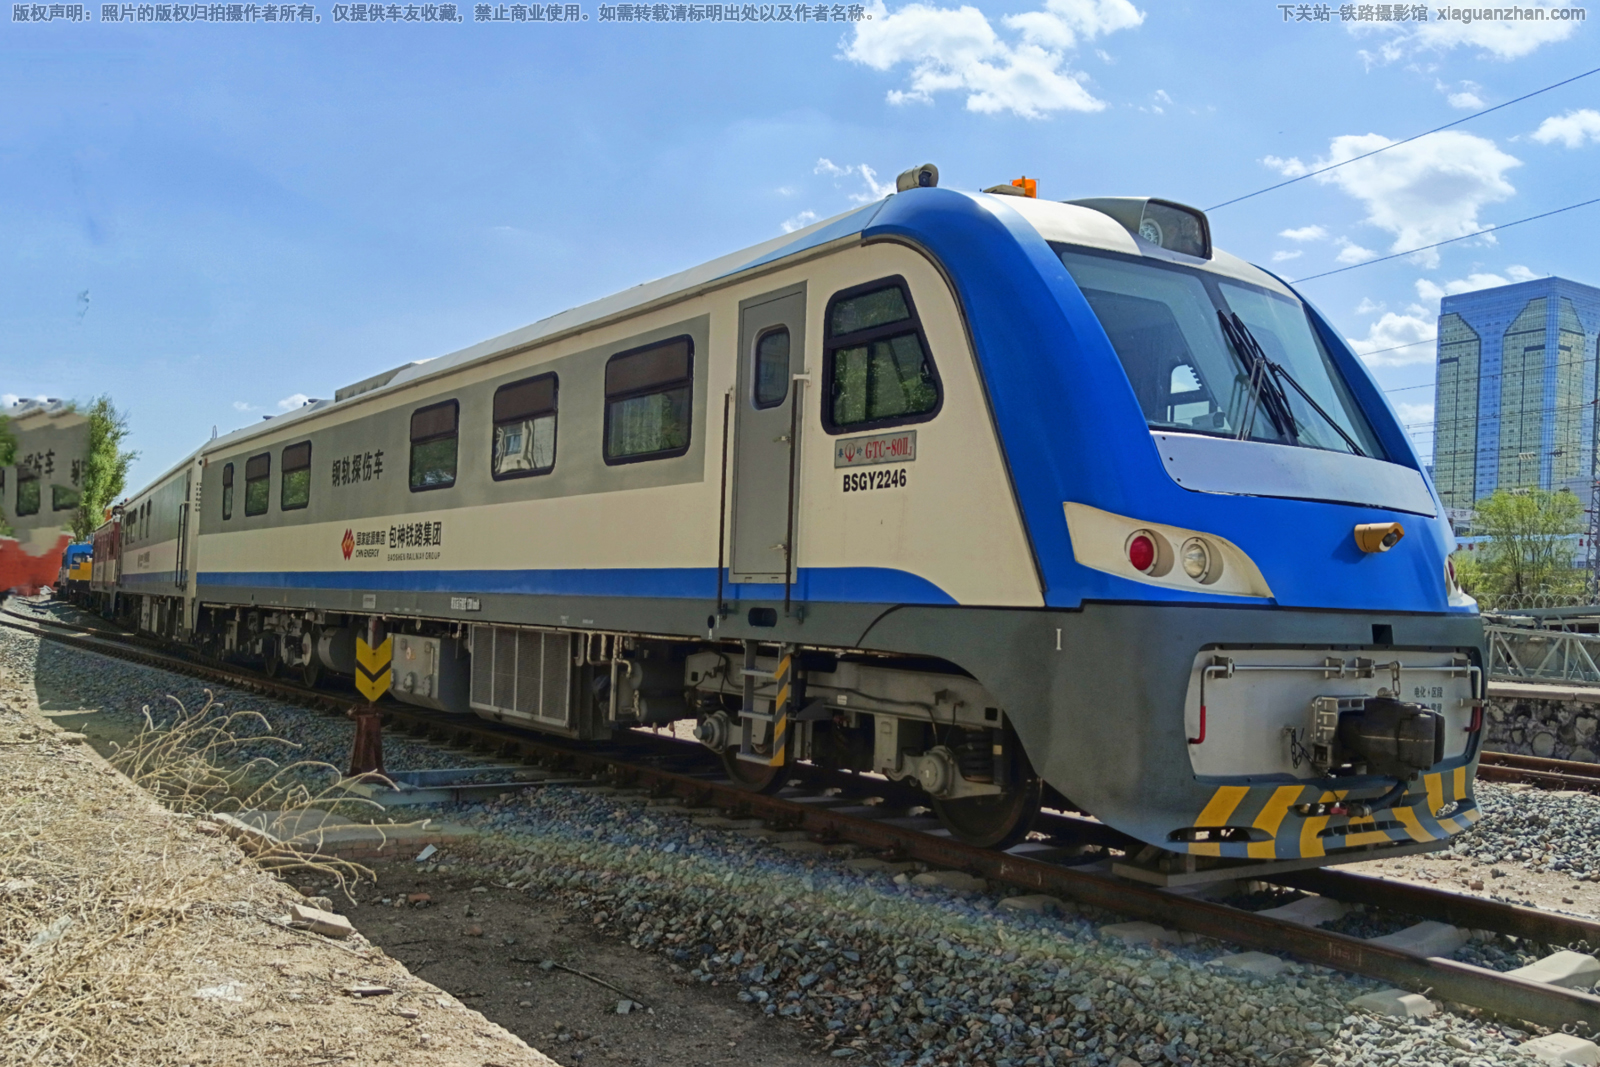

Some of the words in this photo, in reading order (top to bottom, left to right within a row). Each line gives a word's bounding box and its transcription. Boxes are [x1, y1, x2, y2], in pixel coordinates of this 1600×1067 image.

[331, 449, 384, 487] 钢轨探伤车
[843, 468, 907, 492] BSGY2246
[389, 521, 442, 549] 包神铁路集团
